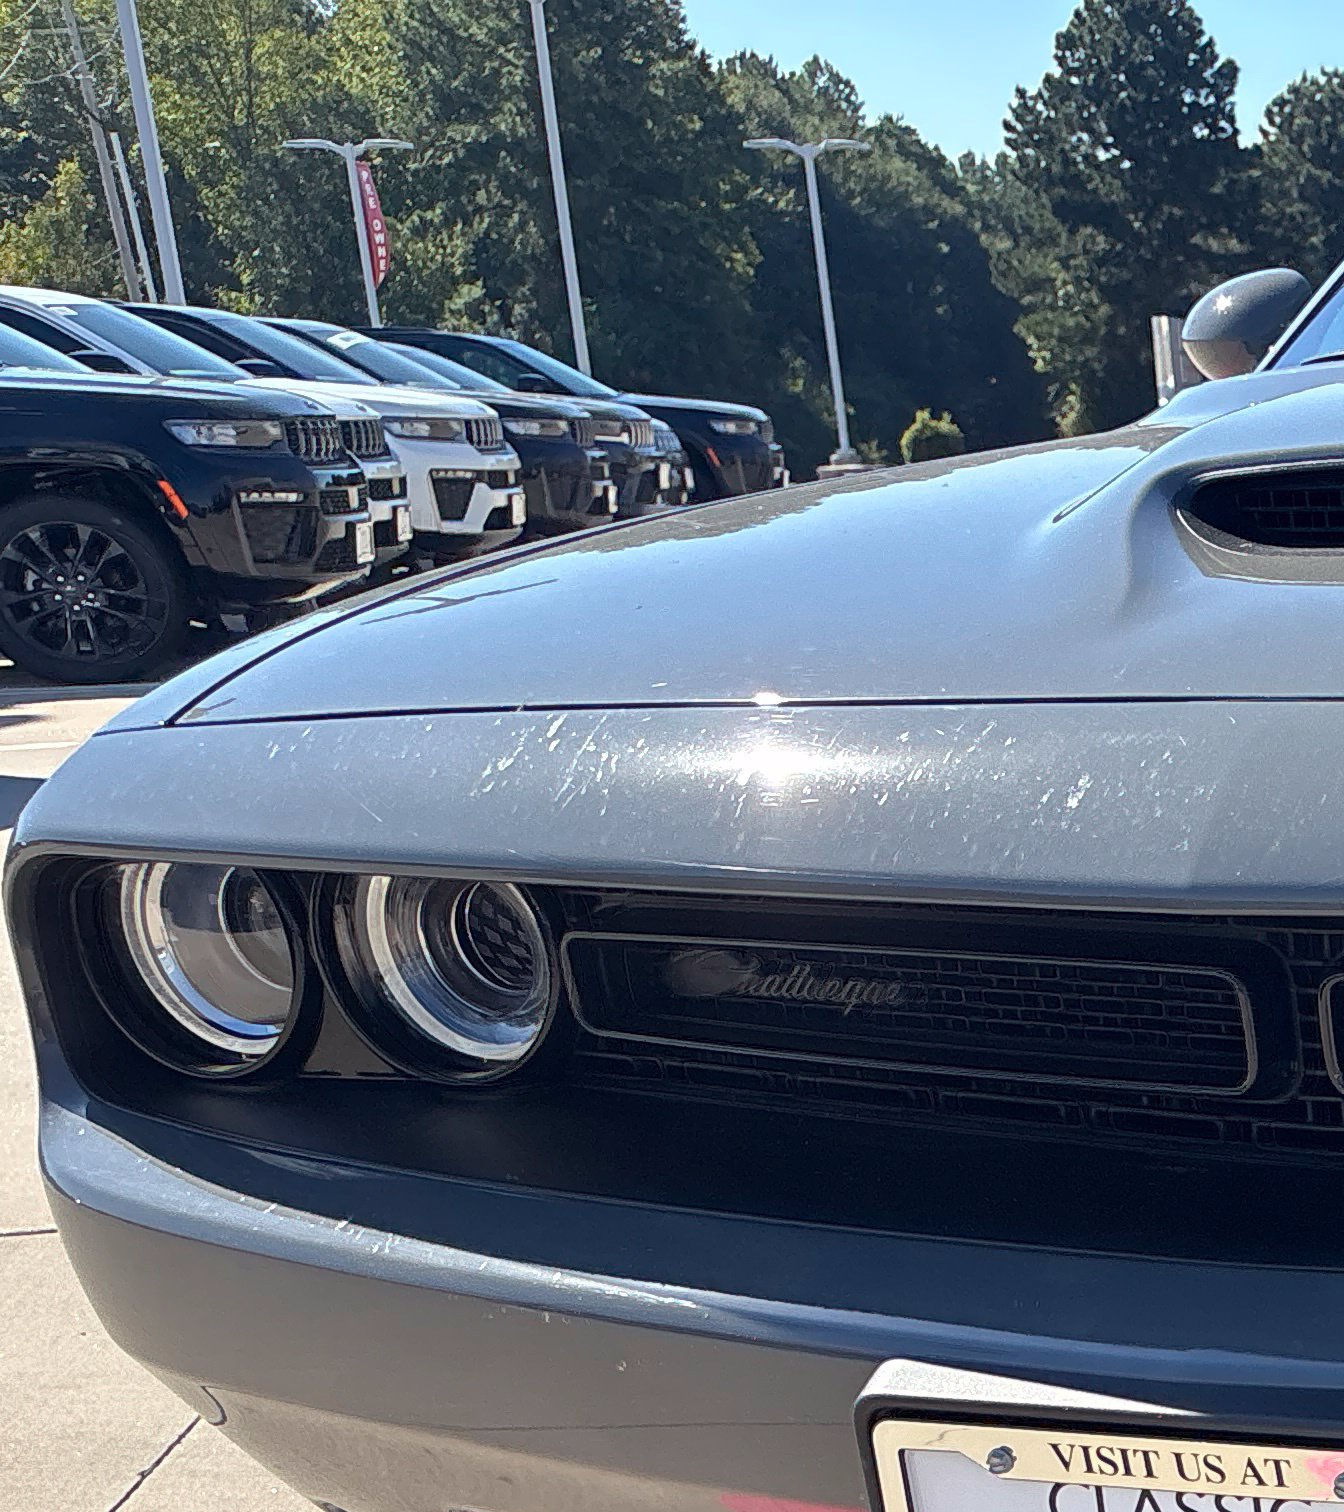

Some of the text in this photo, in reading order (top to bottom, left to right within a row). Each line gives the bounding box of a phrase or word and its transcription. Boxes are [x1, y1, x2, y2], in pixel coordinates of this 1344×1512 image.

[1047, 1442, 1292, 1488] VISIT US AT
